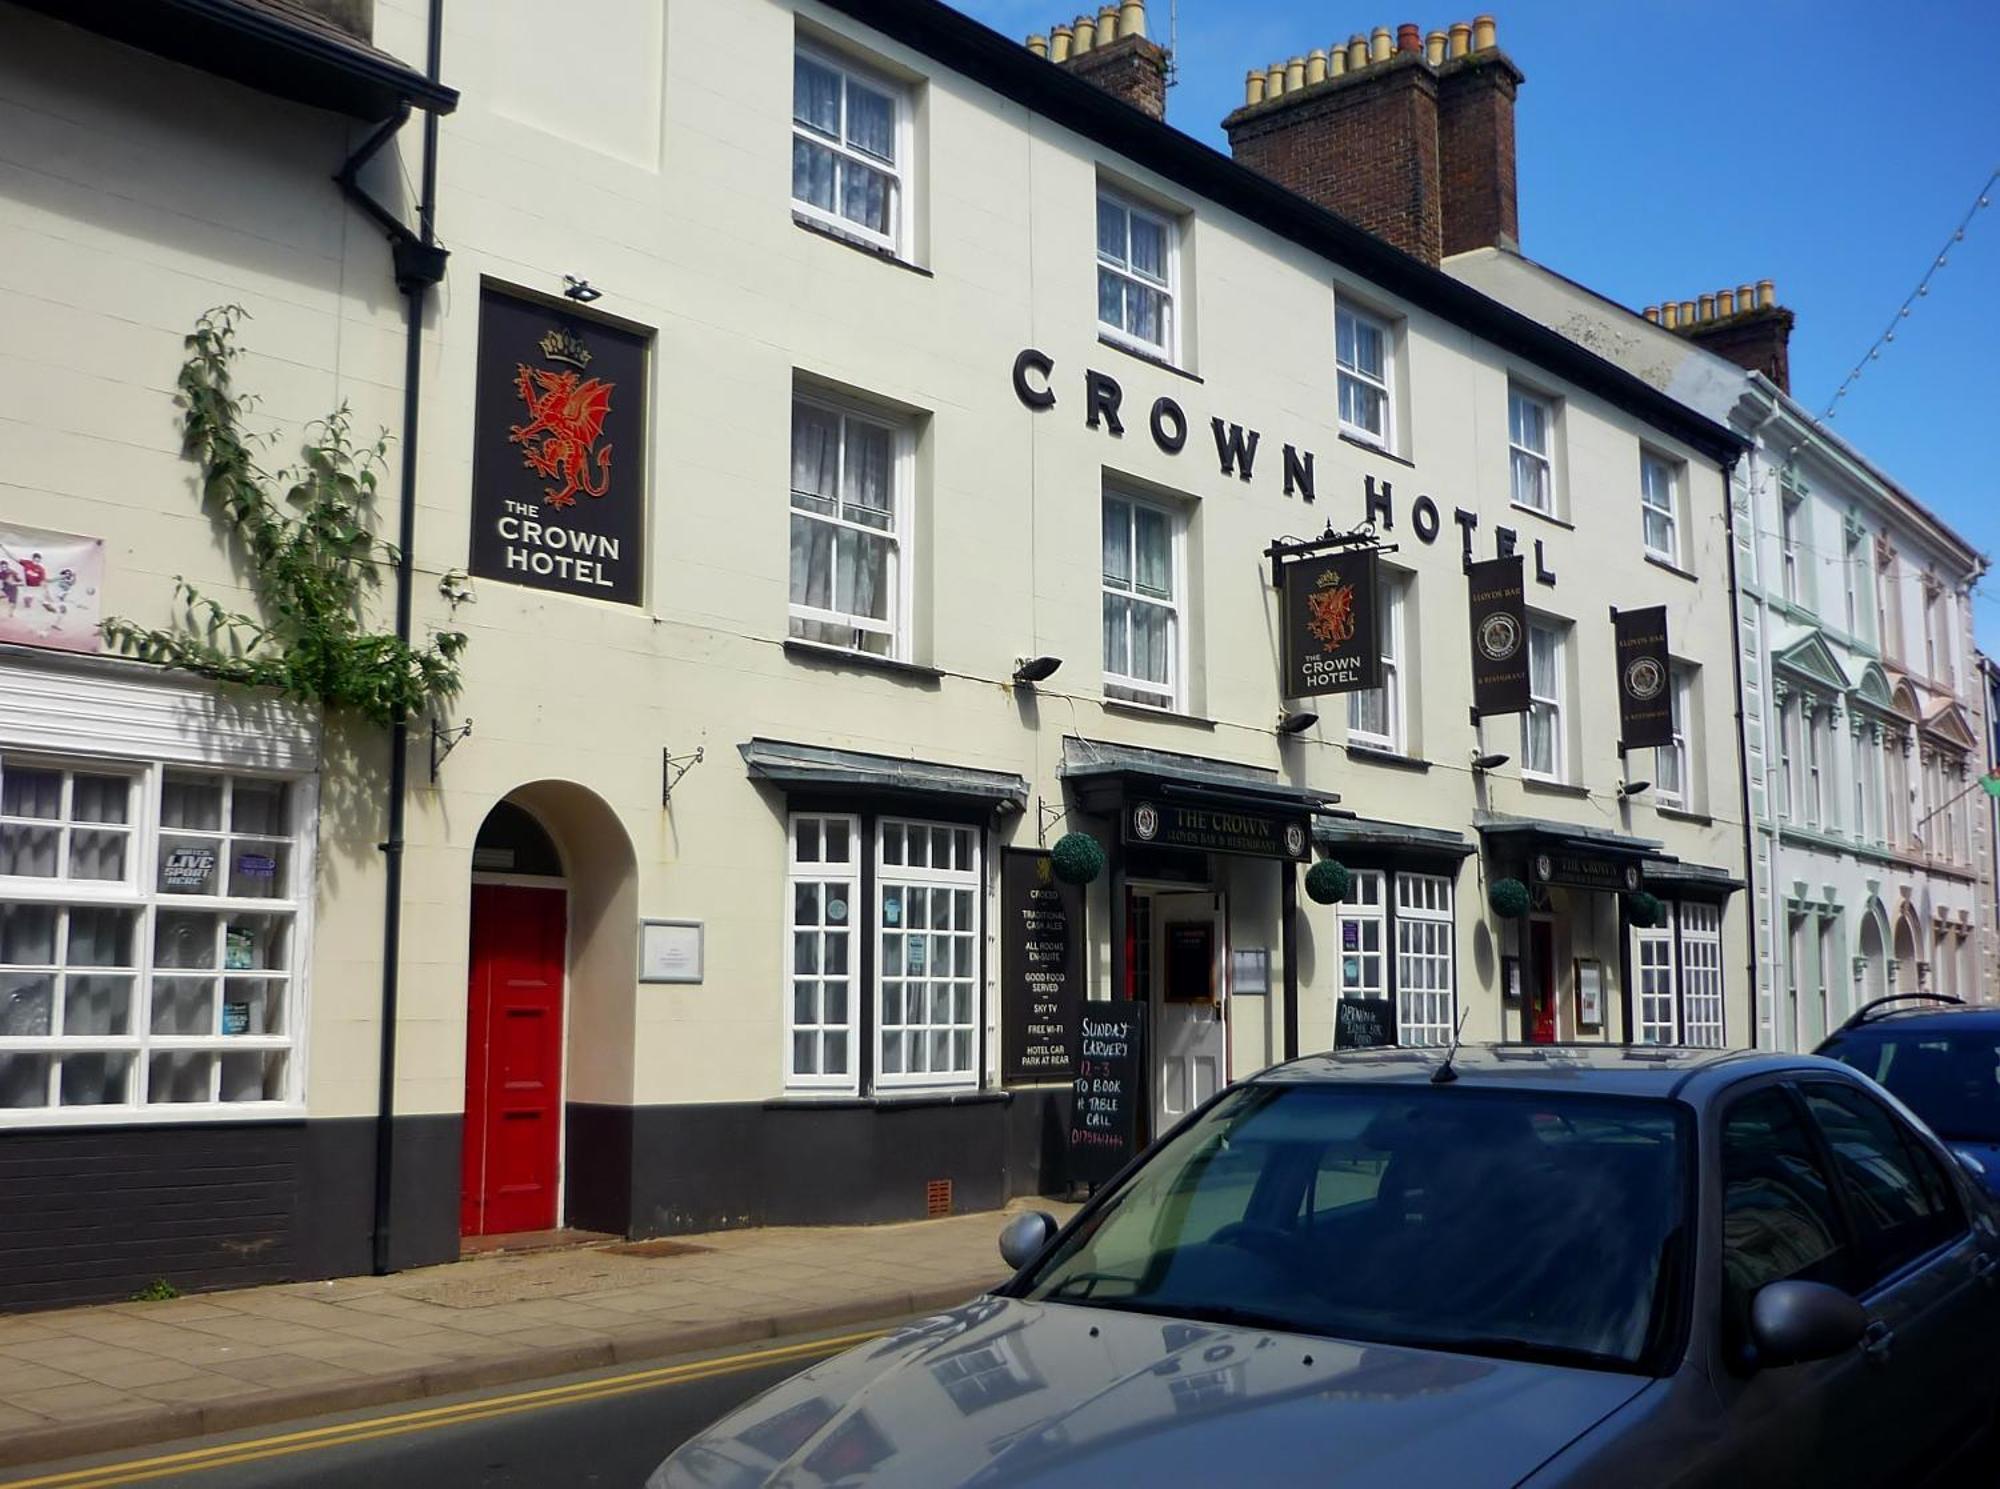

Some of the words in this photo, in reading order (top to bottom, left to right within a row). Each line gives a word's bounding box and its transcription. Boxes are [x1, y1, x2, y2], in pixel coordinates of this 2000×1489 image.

[1013, 348, 1315, 502] CROWN
[1364, 474, 1556, 587] HOTEL
[504, 500, 540, 518] THE
[497, 515, 620, 562] CROWN
[506, 545, 614, 588] HOTEL
[1302, 656, 1361, 674] CROWN
[1305, 654, 1321, 662] THE
[1307, 670, 1359, 687] HOTEL
[1176, 808, 1207, 829] THE
[1212, 814, 1270, 836] CROWN
[167, 855, 214, 868] LIVE
[164, 867, 211, 878] SPORT
[1025, 941, 1039, 951] ALL
[1024, 972, 1046, 982] GOOD
[1046, 973, 1065, 982] FOOD
[1032, 982, 1059, 992] SERVED
[1033, 1003, 1047, 1013] SKY
[1047, 1003, 1058, 1013] TV
[1027, 1024, 1046, 1035] FREE
[1081, 1017, 1131, 1039] SUNDAY
[1027, 1045, 1049, 1055] HOTEL
[1050, 1044, 1065, 1054] CAR
[1083, 1039, 1128, 1057] CARVERY
[1022, 1055, 1041, 1066] PARK
[1041, 1055, 1050, 1065] AT
[1050, 1054, 1069, 1065] REAR
[1074, 1078, 1089, 1093] TO
[1092, 1078, 1121, 1093] BOOK
[1088, 1096, 1118, 1111] TABLE
[1086, 1112, 1112, 1127] CALL
